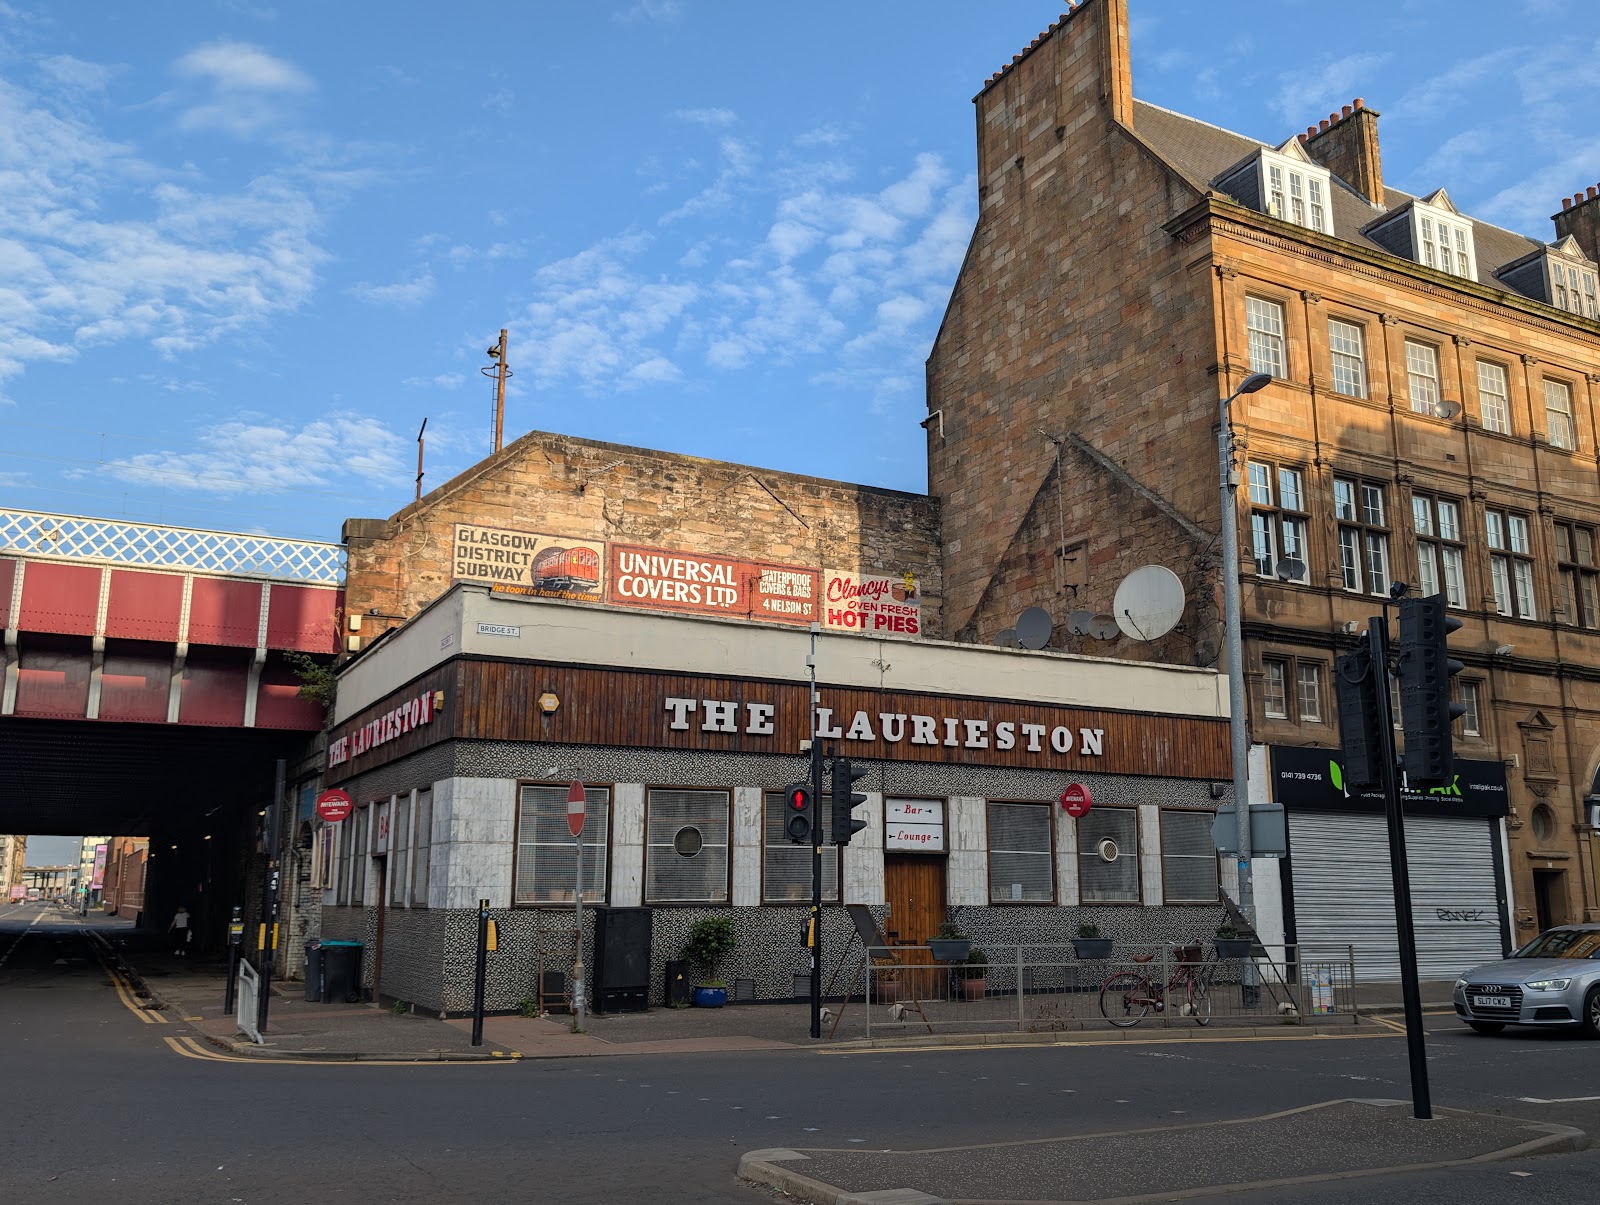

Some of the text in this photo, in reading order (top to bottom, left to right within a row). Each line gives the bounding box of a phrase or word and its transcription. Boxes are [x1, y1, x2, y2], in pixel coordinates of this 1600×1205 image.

[458, 529, 538, 550] GLASGOW
[457, 545, 531, 566] DISTRICT
[456, 561, 526, 581] SUBWAY
[619, 551, 737, 586] UNIVERSAL
[761, 569, 812, 587] WATERPROOF
[505, 585, 526, 595] toon
[527, 587, 537, 596] in
[538, 587, 562, 598] hauf
[561, 590, 577, 599] the
[577, 592, 602, 602] time!
[617, 575, 701, 604] COVERS
[759, 581, 812, 599] COVERS & BAGS
[827, 577, 889, 603] Clancys
[762, 598, 770, 611] 4
[771, 599, 802, 614] NELSON
[847, 600, 918, 617] OVEN FRESH
[480, 625, 505, 634] BRIDGE
[828, 609, 919, 634] HOT PIES
[329, 690, 433, 769] THE LAURIESTON
[665, 697, 1104, 756] THE LAURIESTON
[903, 804, 923, 815] Bar
[897, 830, 932, 844] Lounge
